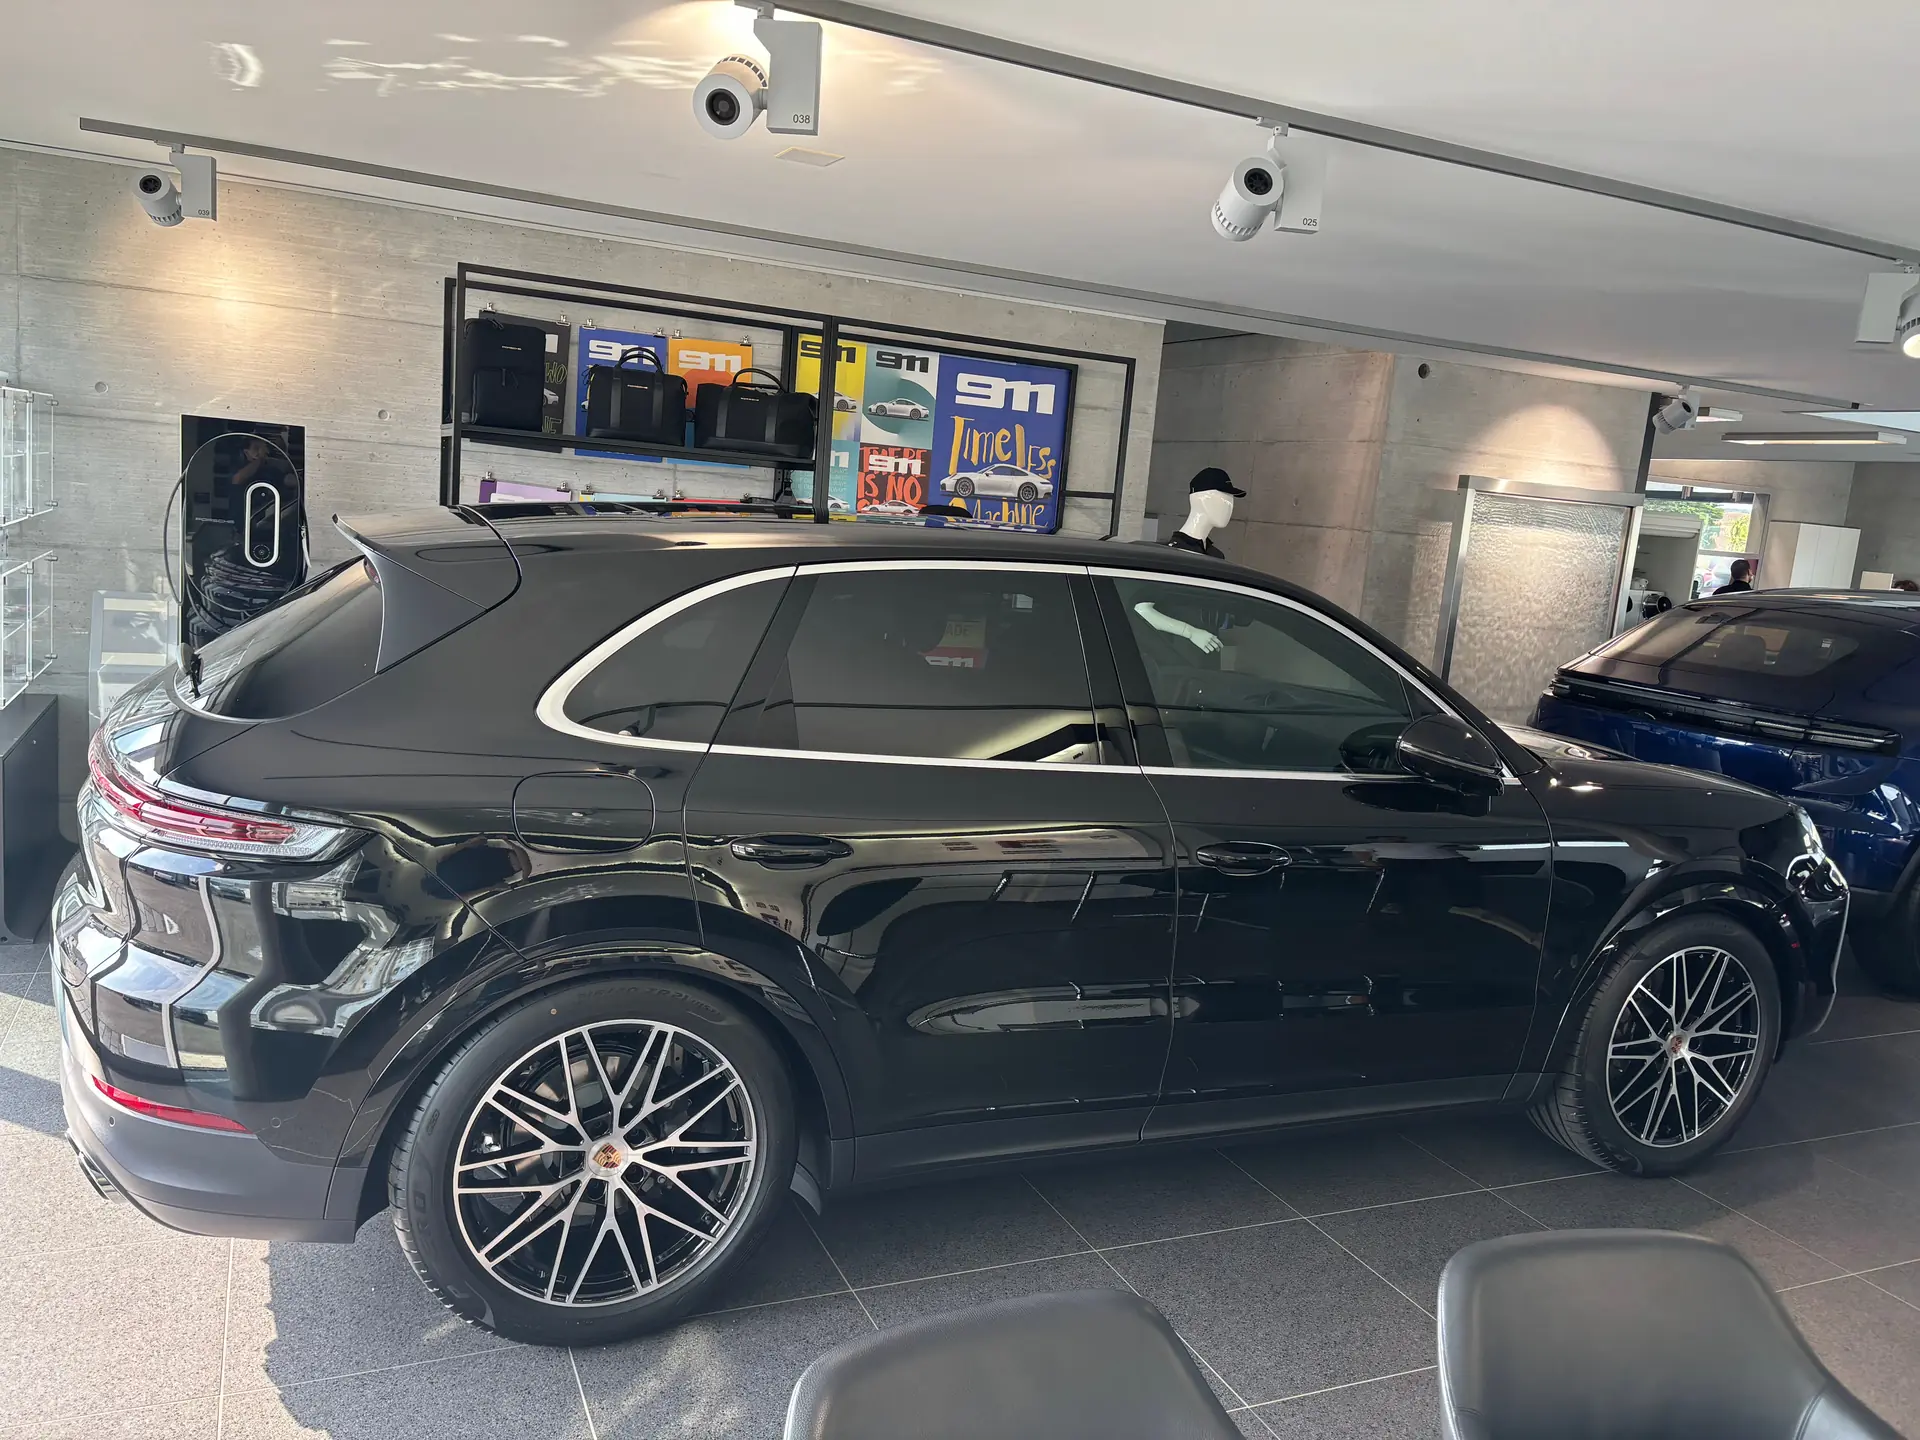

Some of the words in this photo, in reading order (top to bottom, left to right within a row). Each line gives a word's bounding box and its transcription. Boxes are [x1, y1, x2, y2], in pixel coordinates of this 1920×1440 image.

[793, 114, 811, 124] 038
[1302, 217, 1318, 227] 025
[678, 350, 742, 373] 911
[875, 350, 930, 374] 911
[955, 372, 1056, 415] 911
[868, 454, 922, 475] 911
[857, 471, 880, 499] IS
[885, 473, 922, 505] NO
